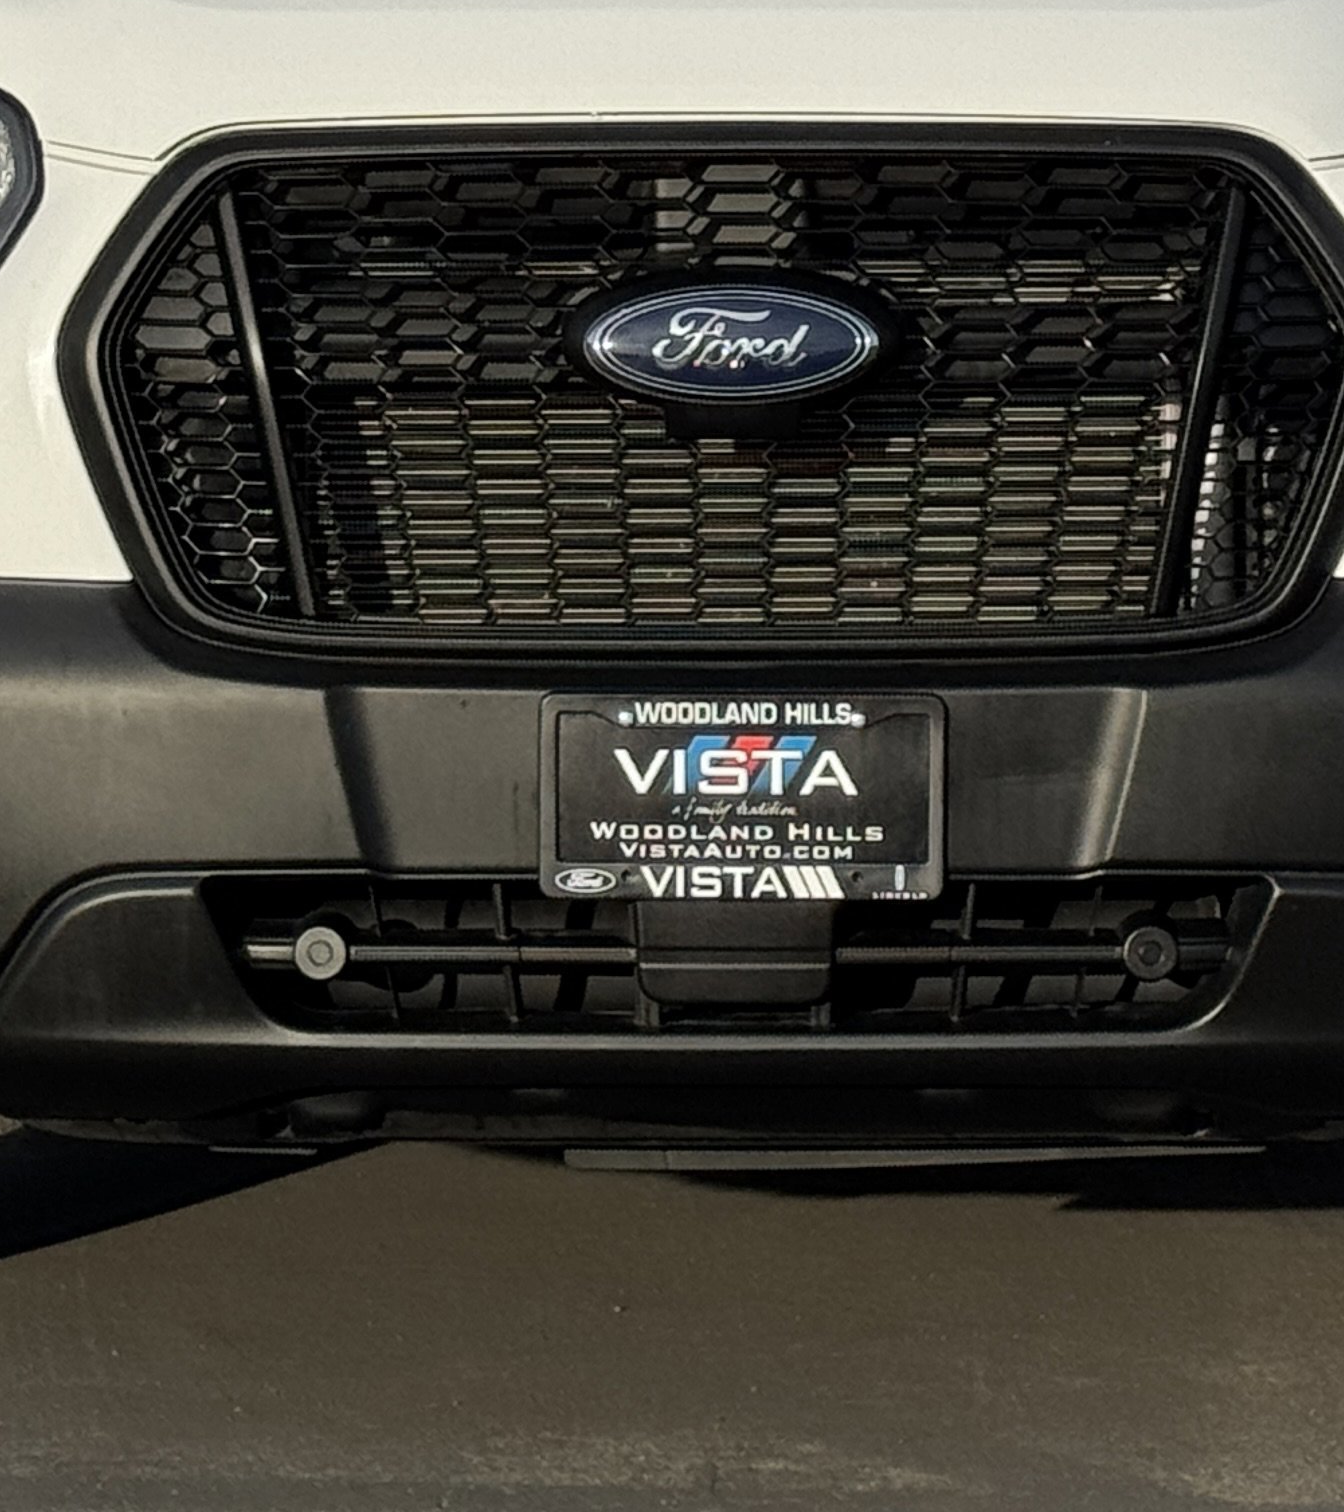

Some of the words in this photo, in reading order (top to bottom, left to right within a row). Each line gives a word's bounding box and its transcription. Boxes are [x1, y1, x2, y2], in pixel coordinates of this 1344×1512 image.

[652, 307, 810, 369] Ford
[635, 702, 778, 726] WOODLAND
[785, 702, 852, 726] HILLS
[613, 748, 859, 796] VISTA
[590, 821, 774, 841] WOODLAND
[788, 821, 885, 842] HILLS
[640, 865, 789, 898] VISTA
